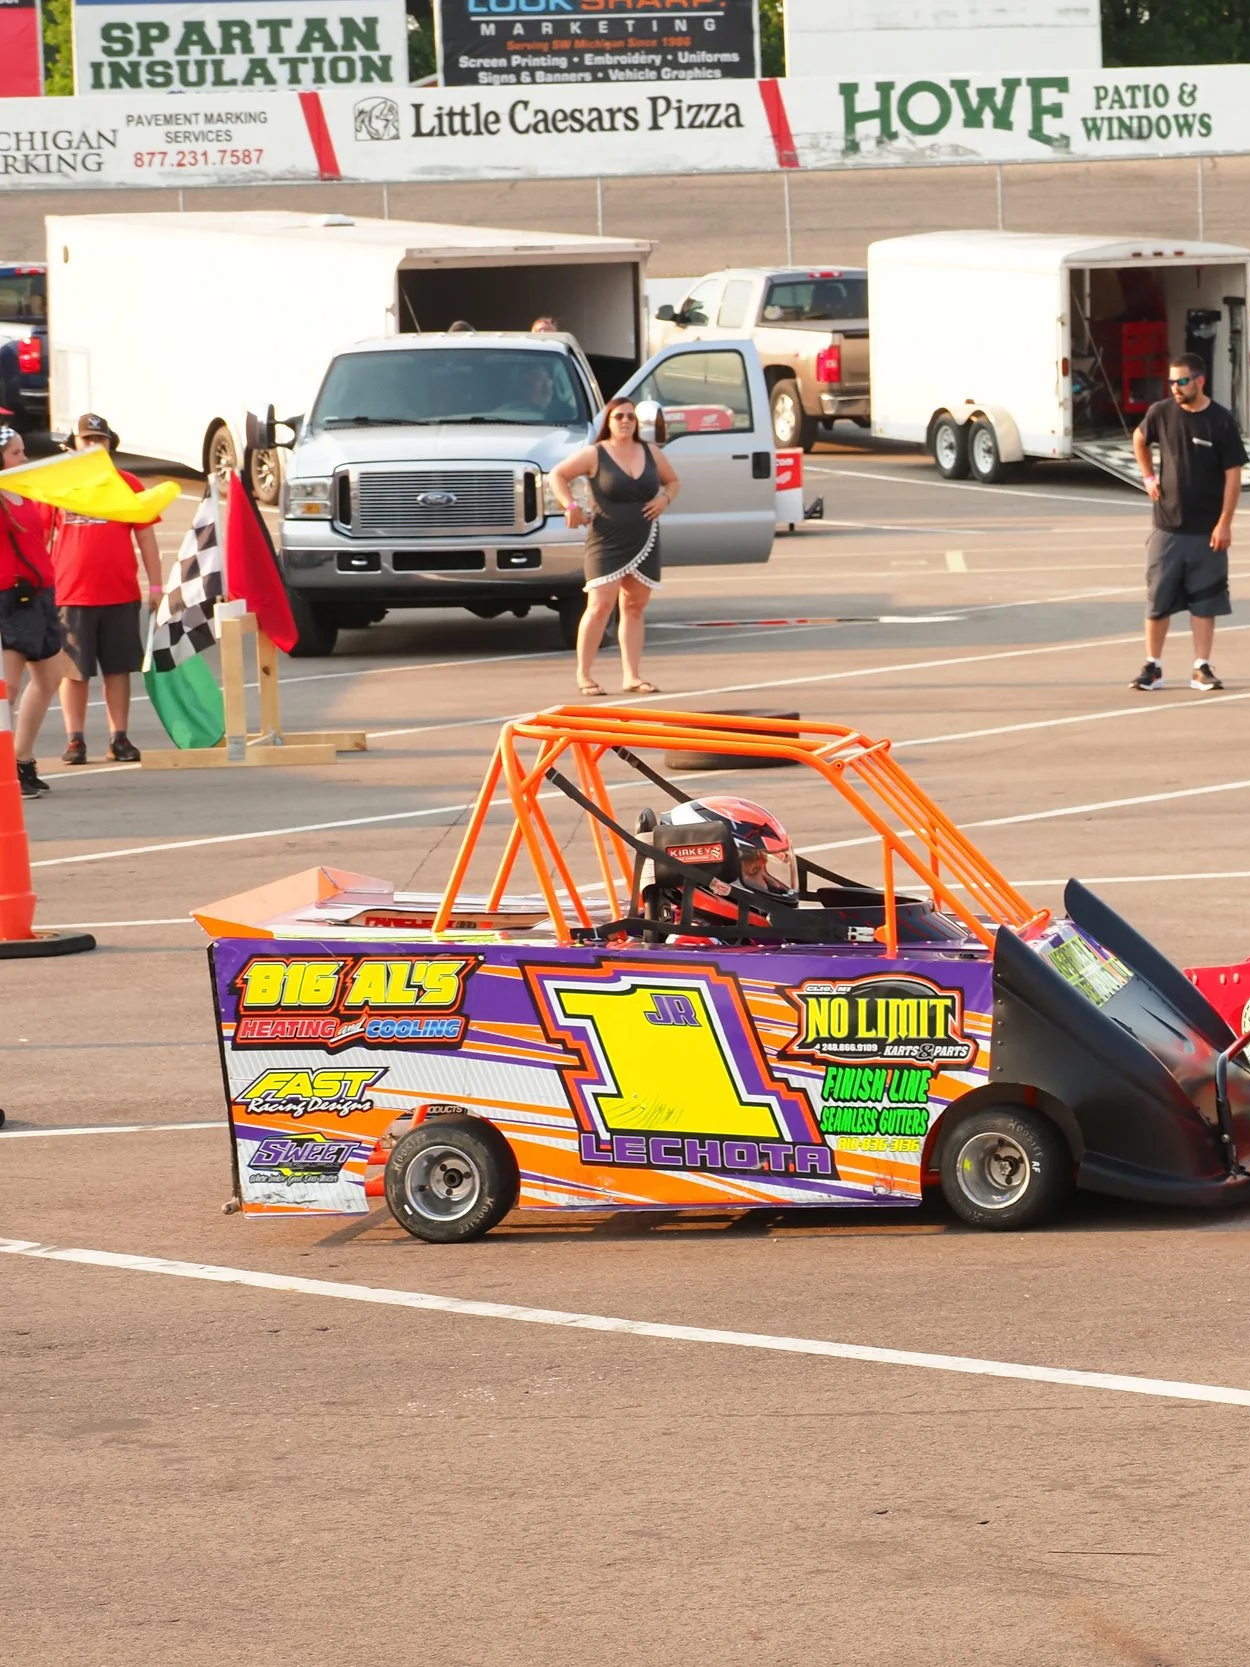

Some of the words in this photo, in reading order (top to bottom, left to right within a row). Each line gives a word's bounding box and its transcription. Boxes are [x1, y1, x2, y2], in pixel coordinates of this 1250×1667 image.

[100, 16, 380, 57] SPARTAN
[481, 19, 717, 36] MARKETING
[573, 38, 625, 51] Michigan
[90, 54, 393, 90] INSULATION
[459, 56, 507, 68] Screen
[511, 54, 568, 69] Printing
[584, 51, 662, 67] Embroidery
[678, 51, 739, 63] Uniforms
[478, 72, 517, 85] Signs
[520, 72, 532, 83] &
[536, 71, 592, 83] Banners
[608, 69, 657, 81] Vehicle
[661, 67, 722, 81] Graphics
[126, 113, 200, 127] PAVEMENT
[203, 111, 268, 125] MARKING
[411, 101, 500, 138] Little
[508, 100, 640, 135] Caesars
[647, 95, 744, 131] Pizza
[839, 77, 1071, 155] HOWE
[1094, 83, 1169, 110] PATIO
[1178, 82, 1197, 106] &
[1081, 114, 1213, 141] WINDOWS
[165, 130, 232, 144] SERVICES
[0, 153, 104, 174] RKING
[134, 149, 264, 168] 877.231.7587
[670, 847, 711, 857] KIRKEY
[244, 961, 344, 1006] BIG
[345, 961, 465, 1006] AL'S
[806, 985, 833, 993] CLIO,
[644, 993, 702, 1028] JR
[804, 997, 850, 1043] NO
[855, 997, 953, 1043] LIMIT
[239, 1018, 338, 1039] HEATING
[338, 1017, 366, 1040] and
[366, 1018, 462, 1039] COOLING
[821, 1043, 879, 1052] 248.866.9109
[552, 984, 785, 1140] 1
[243, 1070, 379, 1099] FAST
[822, 1066, 888, 1101] FINISH
[887, 1067, 932, 1103] LINE
[248, 1097, 306, 1117] Racing
[308, 1096, 372, 1117] Designs
[820, 1106, 880, 1135] SEAMLESS
[879, 1107, 929, 1136] GUTTERS
[250, 1139, 360, 1166] SWEET
[580, 1134, 832, 1175] LECHOTA
[838, 1137, 920, 1152] 810-836-3136
